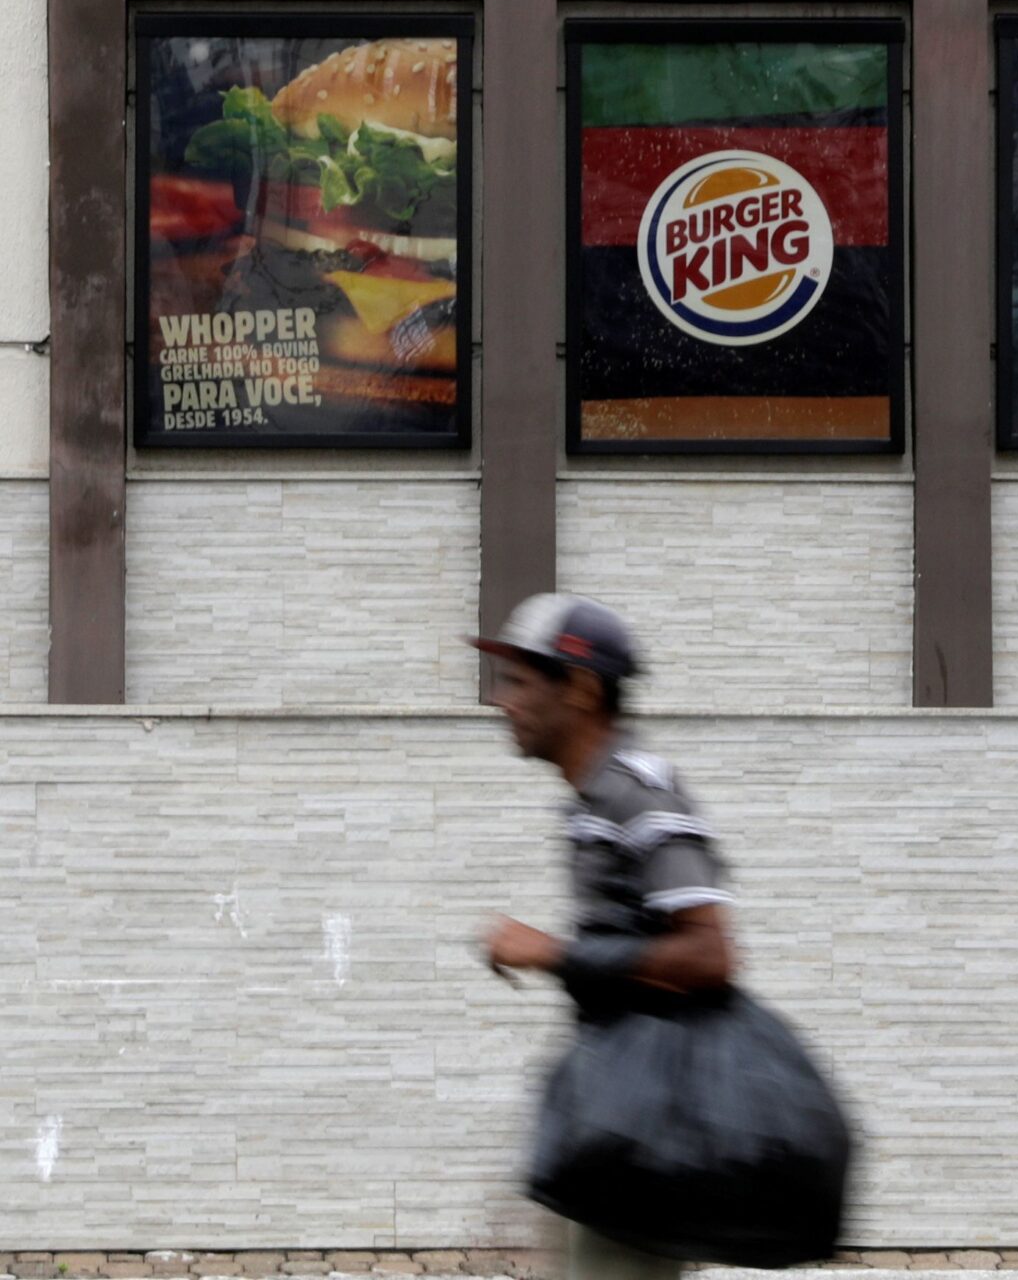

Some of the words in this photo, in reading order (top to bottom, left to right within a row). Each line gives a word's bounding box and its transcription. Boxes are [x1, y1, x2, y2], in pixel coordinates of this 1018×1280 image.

[666, 189, 804, 256] BURGER
[673, 220, 810, 302] KING
[159, 307, 316, 347] WHOPPER
[160, 348, 208, 364] CARNE
[215, 344, 257, 361] 100%
[262, 341, 319, 358] BOVINA
[161, 362, 244, 381] GRELHADA
[249, 360, 272, 377] NO
[278, 358, 320, 374] FOGO
[163, 380, 237, 412] PARA
[164, 411, 216, 430] DESDE
[222, 407, 268, 427] 1954.
